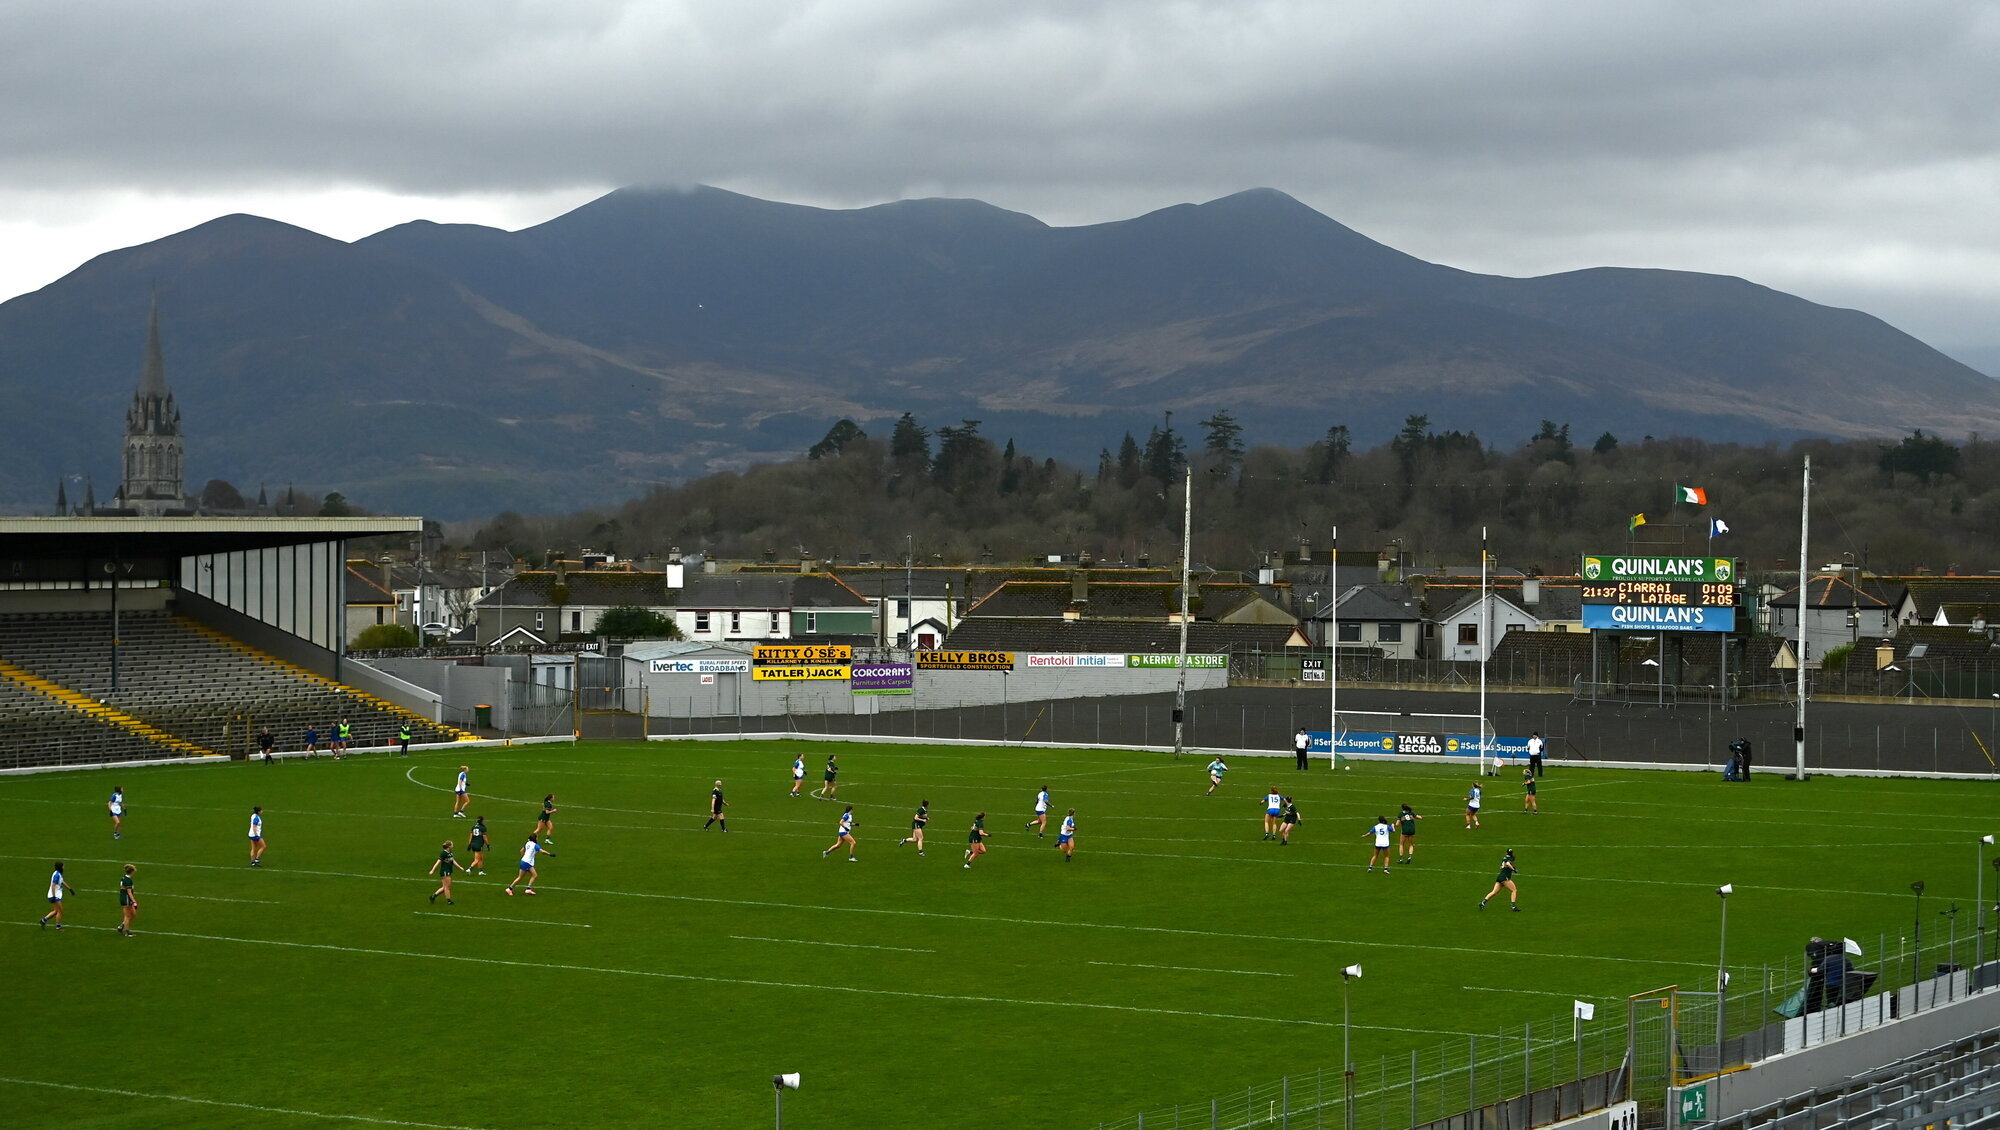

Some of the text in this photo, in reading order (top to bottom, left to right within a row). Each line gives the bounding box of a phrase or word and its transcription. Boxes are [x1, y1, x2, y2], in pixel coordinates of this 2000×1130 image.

[1612, 558, 1704, 575] QUINLAN'S
[1582, 587, 1617, 598] 21:37
[1618, 583, 1733, 594] CIARRAI 0:09
[1618, 593, 1733, 605] P. LAIRGE 2:05
[1612, 606, 1704, 623] QUINLAN'S
[758, 649, 800, 658] KITTY
[920, 652, 1010, 663] KELLY BROS.
[1030, 656, 1074, 665] Rentokil
[1077, 656, 1105, 665] Initial
[1143, 656, 1223, 664] KERRY GA STORE
[653, 661, 693, 671] ivertec
[812, 669, 842, 677] JACK
[852, 667, 911, 677] CORCORAN'S
[1314, 738, 1347, 747] #Serous
[1349, 739, 1380, 749] Support
[1399, 736, 1426, 744] TAKE
[1429, 736, 1437, 744] A
[1399, 744, 1441, 753] SECOND
[1460, 742, 1495, 751] #Serius
[1496, 743, 1528, 753] Support
